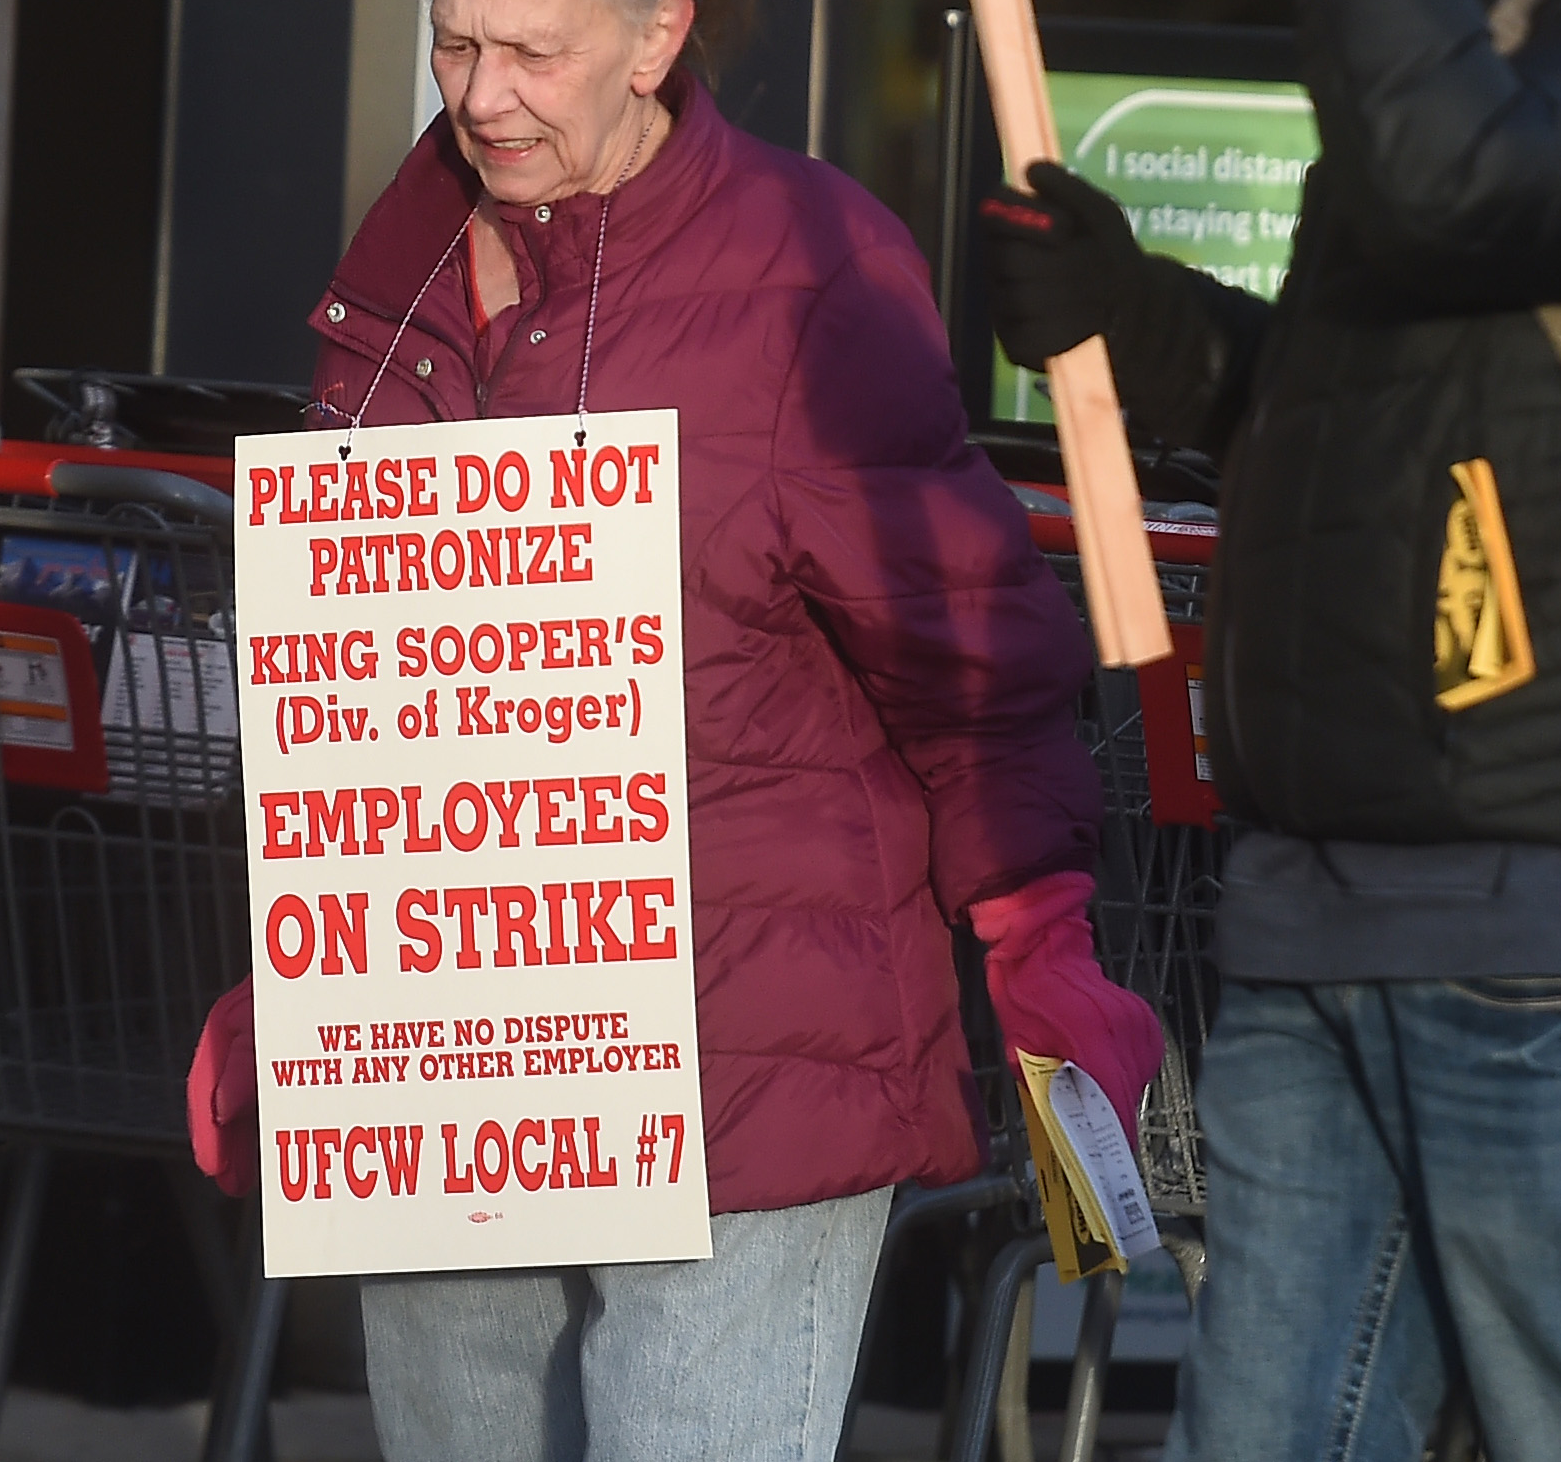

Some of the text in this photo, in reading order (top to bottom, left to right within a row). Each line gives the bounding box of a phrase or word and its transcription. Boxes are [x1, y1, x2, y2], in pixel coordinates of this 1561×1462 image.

[1123, 144, 1209, 181] social
[1213, 146, 1305, 184] distan
[1148, 201, 1252, 247] staying
[1258, 207, 1300, 239] tw
[250, 445, 659, 526] PLEASE DO NOT
[310, 523, 593, 596] PATRONIZE
[250, 630, 378, 685] KING
[397, 615, 663, 677] SOOPER'S
[277, 679, 641, 754] (Div. of Kroger)
[260, 773, 669, 859] EMPLOYEES
[267, 878, 677, 979] ON STRIKE
[272, 1043, 681, 1086] WITH ANY OTHER EMPLOYER
[319, 1012, 628, 1051] WE HAVE NO DISPUTE
[277, 1114, 684, 1202] UFCW LOCAL #7
